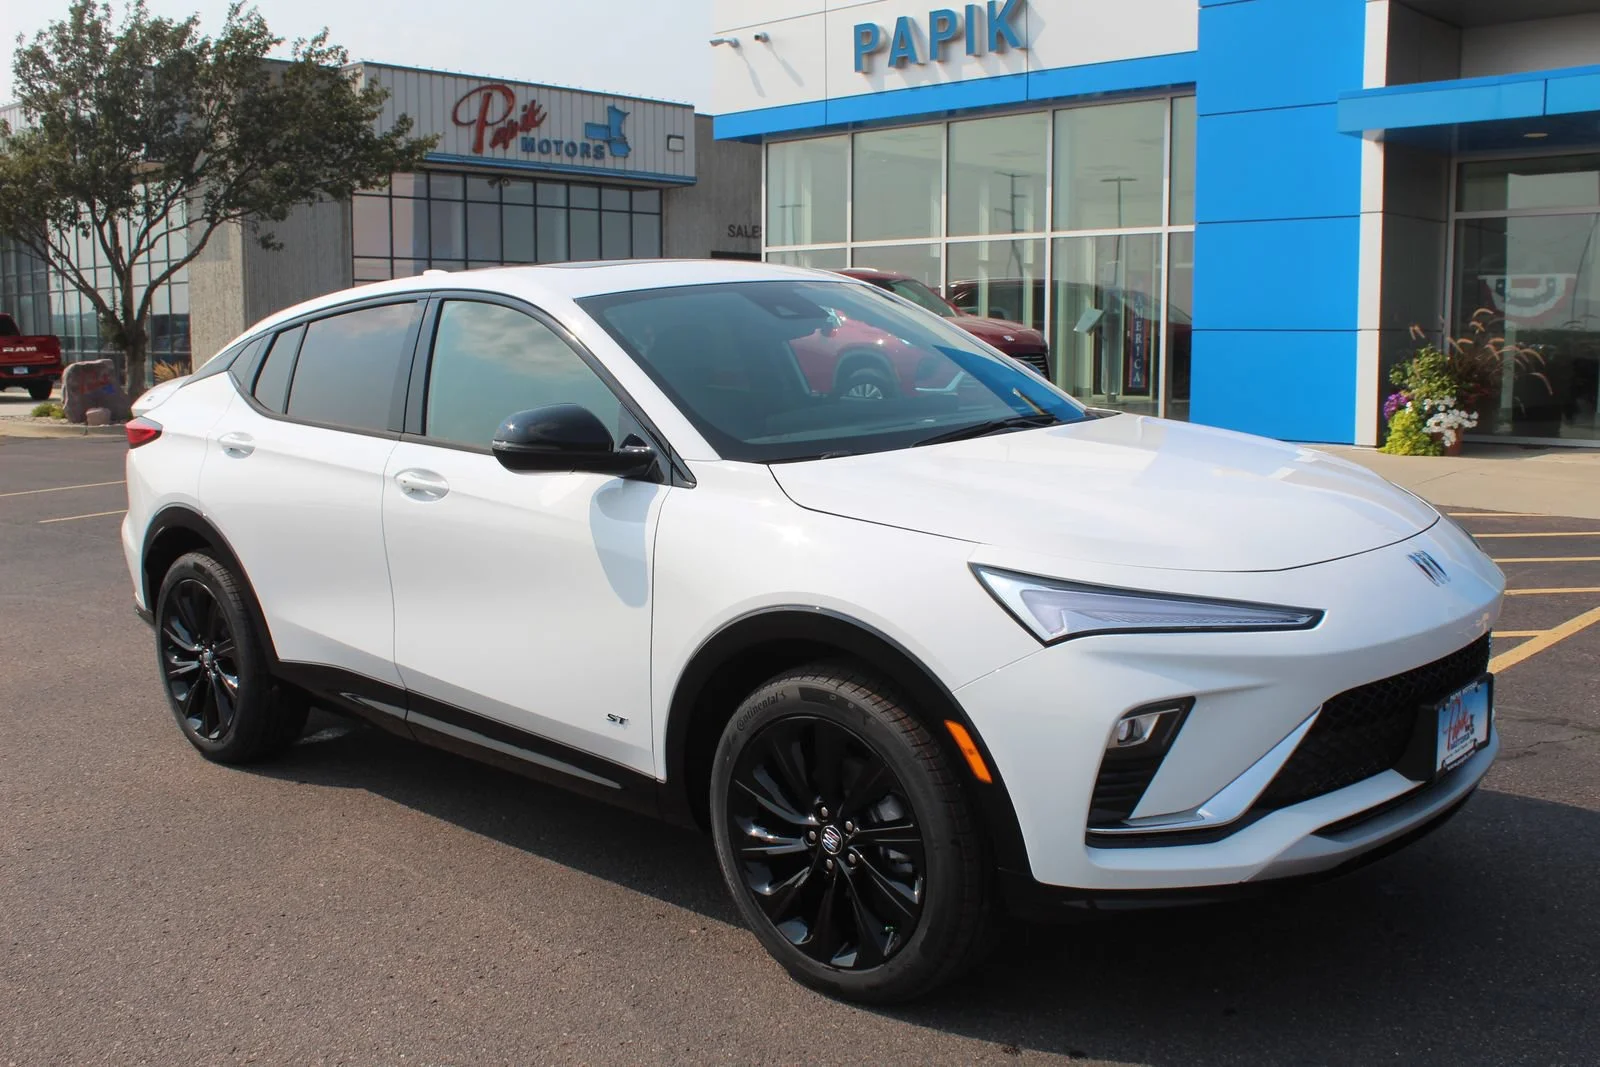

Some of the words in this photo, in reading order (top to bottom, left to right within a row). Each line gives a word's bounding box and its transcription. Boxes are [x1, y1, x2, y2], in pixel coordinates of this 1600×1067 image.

[853, 0, 1023, 73] PAPIK
[452, 84, 547, 154] Papik
[521, 136, 605, 160] MOTORS
[727, 224, 762, 239] SALE
[606, 713, 629, 725] ST
[736, 692, 779, 731] Continental
